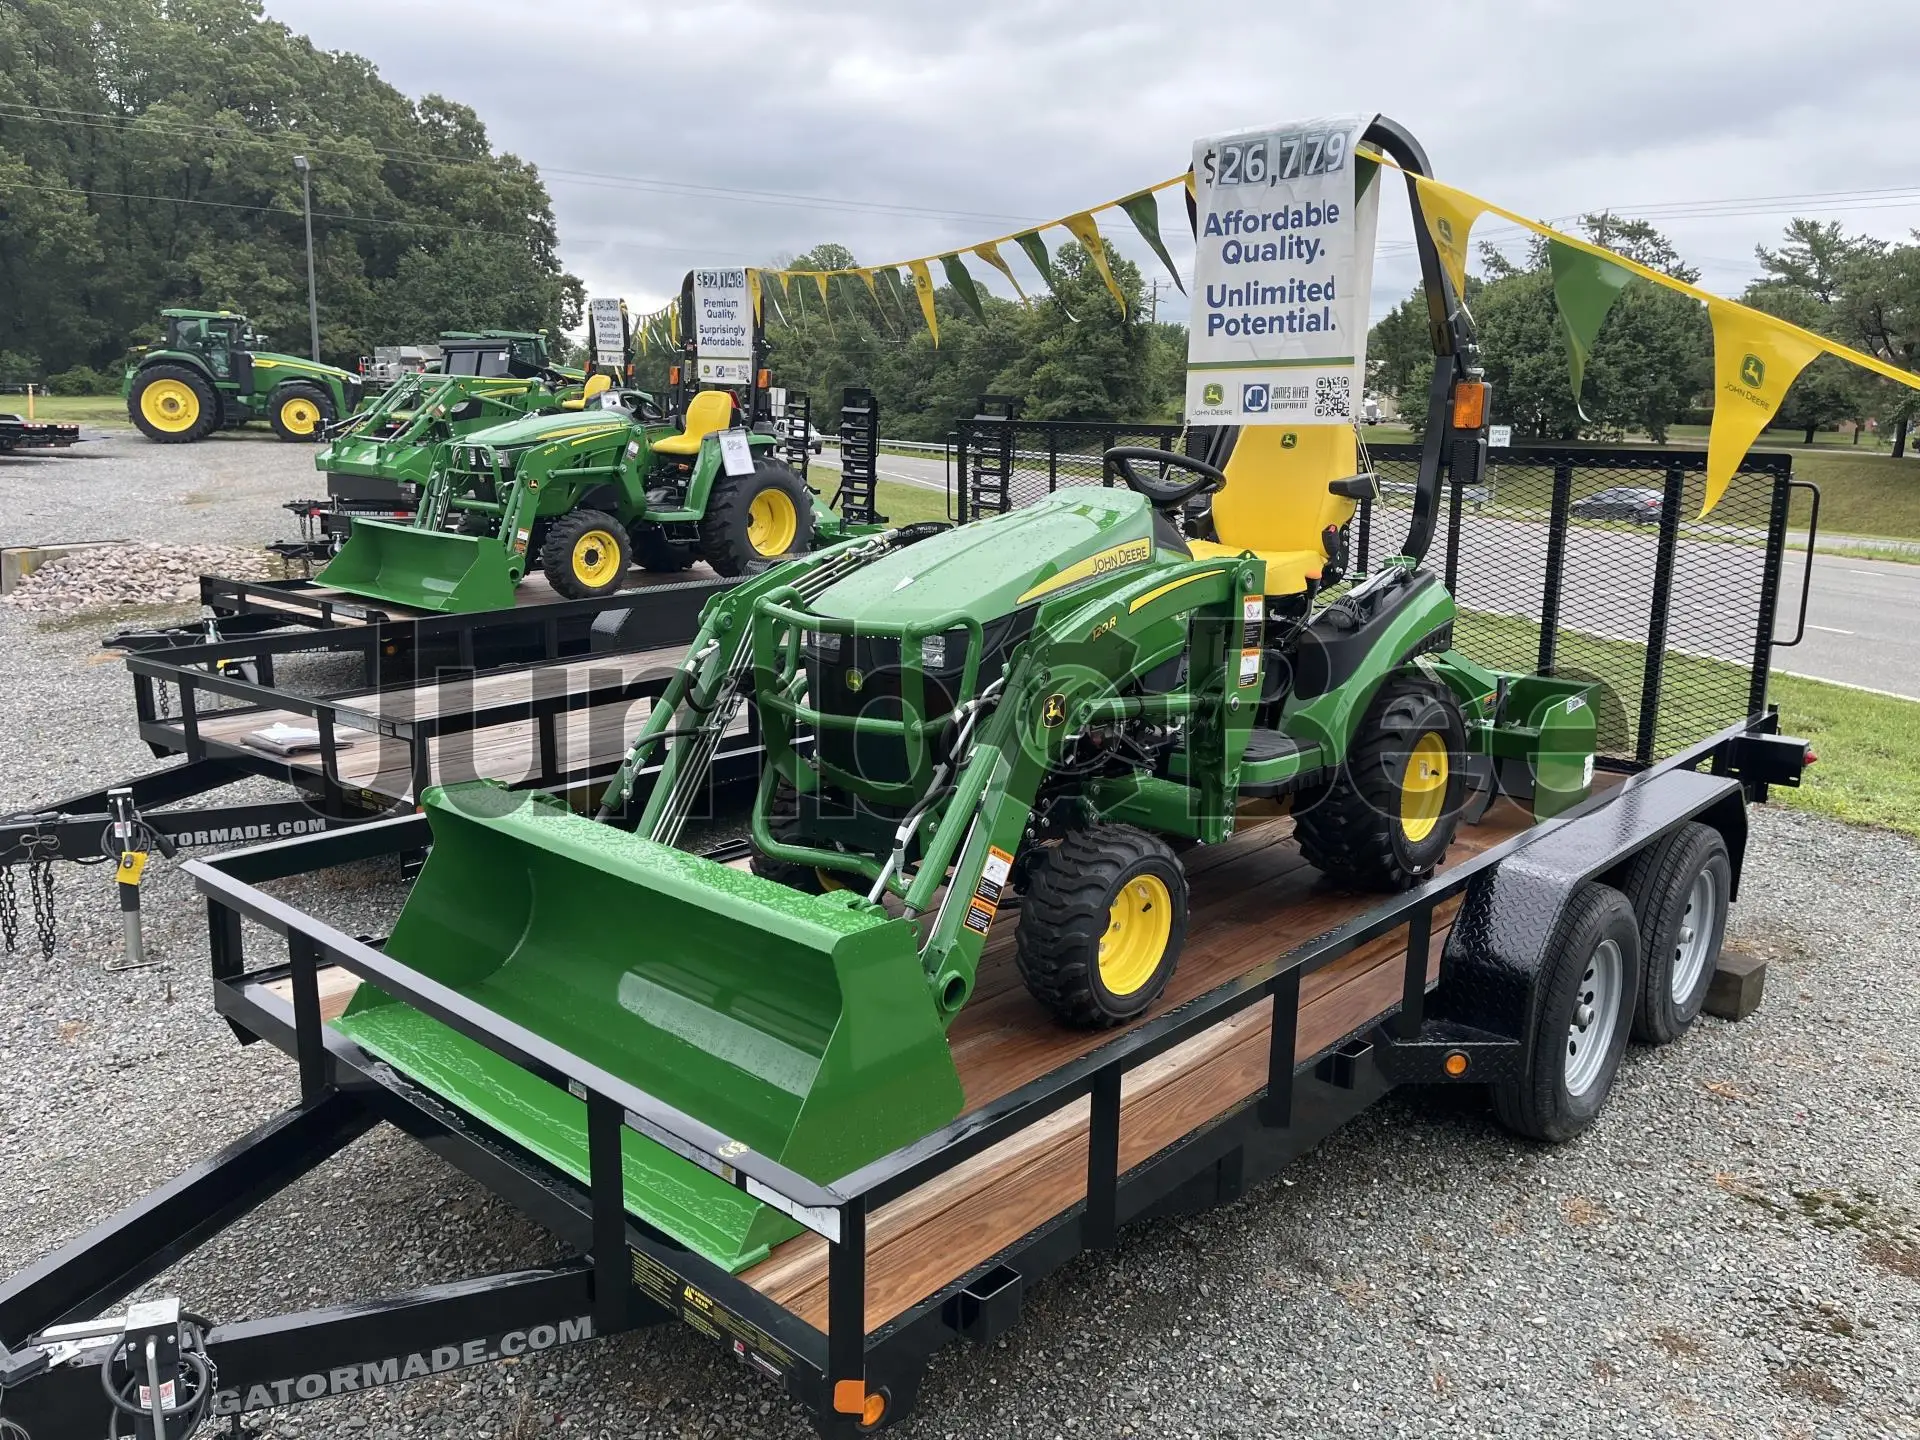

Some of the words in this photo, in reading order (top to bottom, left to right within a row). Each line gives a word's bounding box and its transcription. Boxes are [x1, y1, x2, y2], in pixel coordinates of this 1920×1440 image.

[1203, 132, 1345, 188] $26,779
[1203, 199, 1340, 238] Affordable
[1222, 233, 1325, 265] Quality.
[697, 271, 744, 291] $32,148
[1206, 274, 1336, 309] Unlimited
[703, 298, 738, 308] Premium
[706, 309, 737, 320] Quality.
[699, 325, 746, 336] Surprisingly
[1207, 306, 1336, 337] Potential.
[700, 337, 744, 347] Affordable.
[1724, 382, 1745, 397] JOHN
[1746, 391, 1770, 411] DEERE
[1091, 556, 1118, 576] JOHN
[1119, 546, 1148, 566] DEERE
[140, 818, 327, 849] TORMADE.COM
[211, 1316, 592, 1416] GATORMADE.COM
